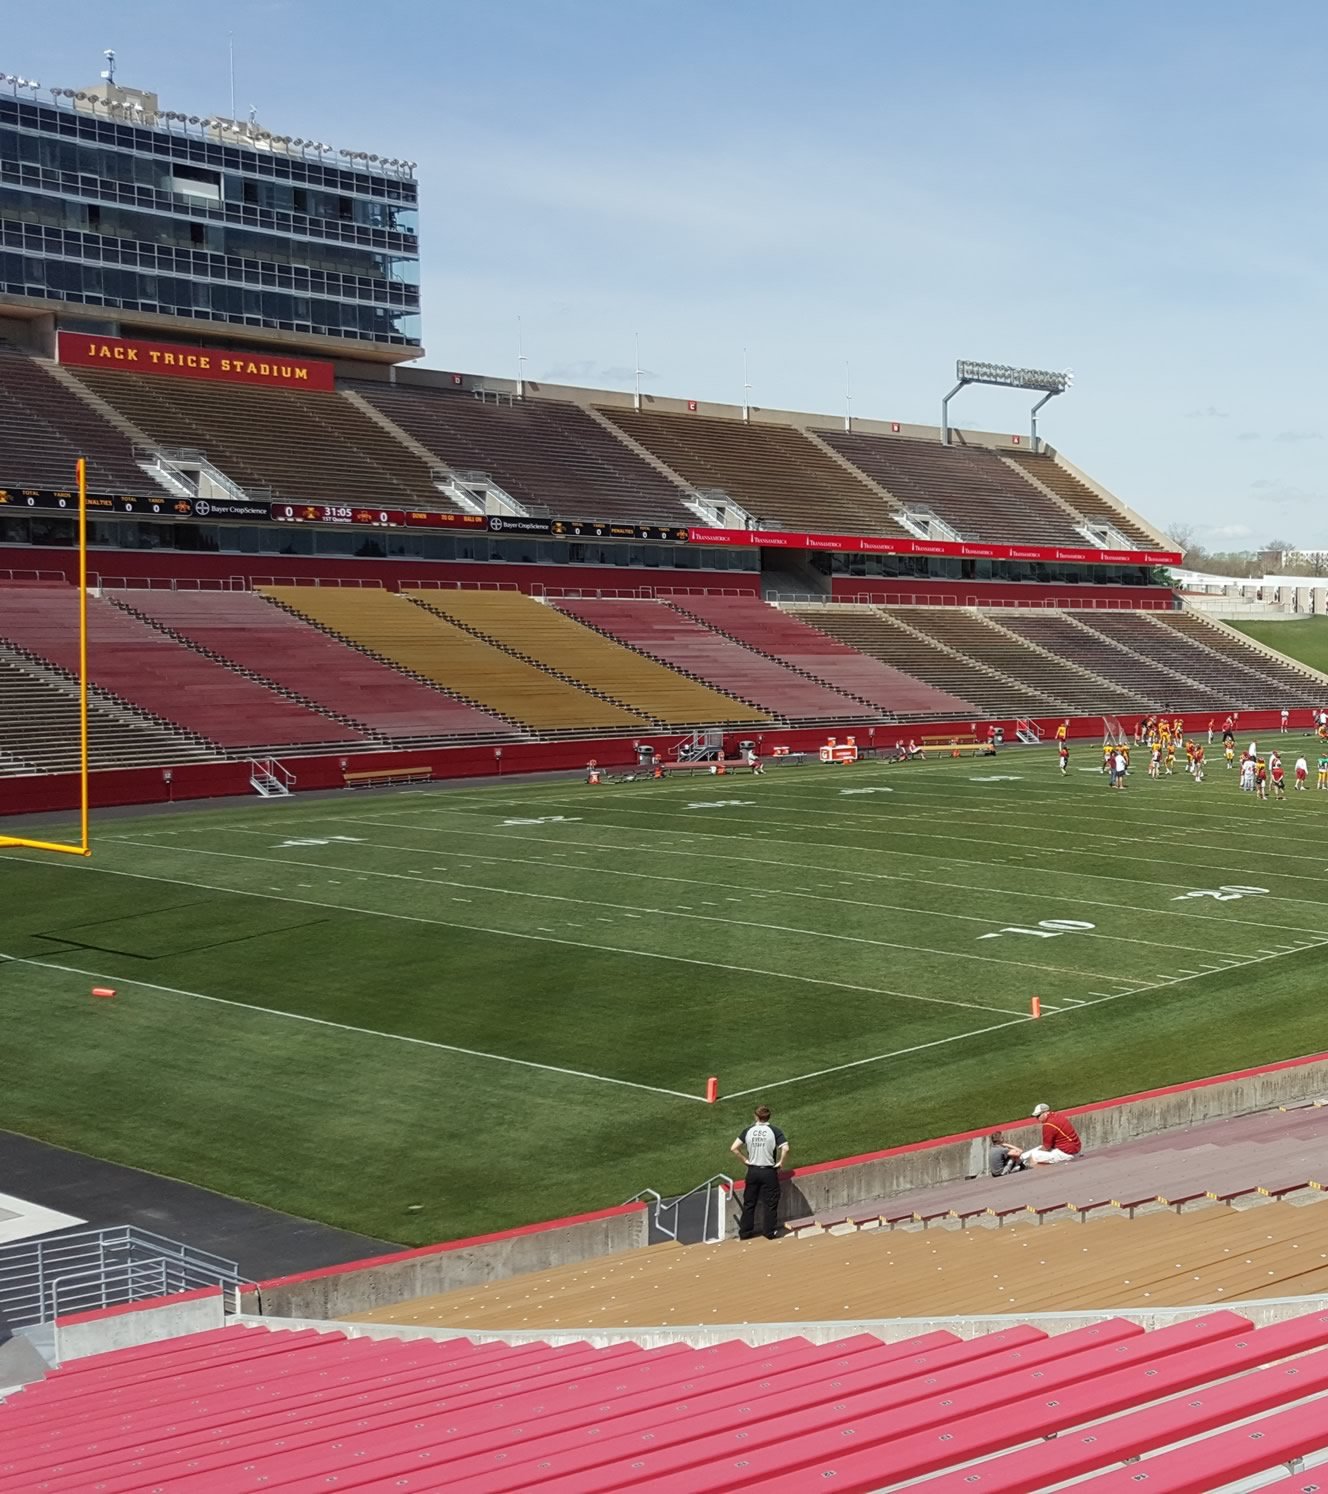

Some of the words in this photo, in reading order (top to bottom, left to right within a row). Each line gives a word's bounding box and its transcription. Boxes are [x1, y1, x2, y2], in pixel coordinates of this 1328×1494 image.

[88, 344, 138, 361] JACK
[150, 351, 210, 369] TRICE
[221, 359, 308, 380] STADIUM
[27, 497, 35, 506] 0
[59, 499, 66, 508] 0
[125, 503, 133, 512] 0
[153, 504, 160, 513] 0
[211, 505, 229, 514] Bayer
[229, 506, 267, 516] CropScience
[285, 507, 293, 517] 0
[324, 506, 352, 518] 31:05
[380, 512, 388, 522] 0
[518, 522, 549, 530] CropScience
[1186, 885, 1270, 901] 20
[1000, 919, 1096, 938] 10
